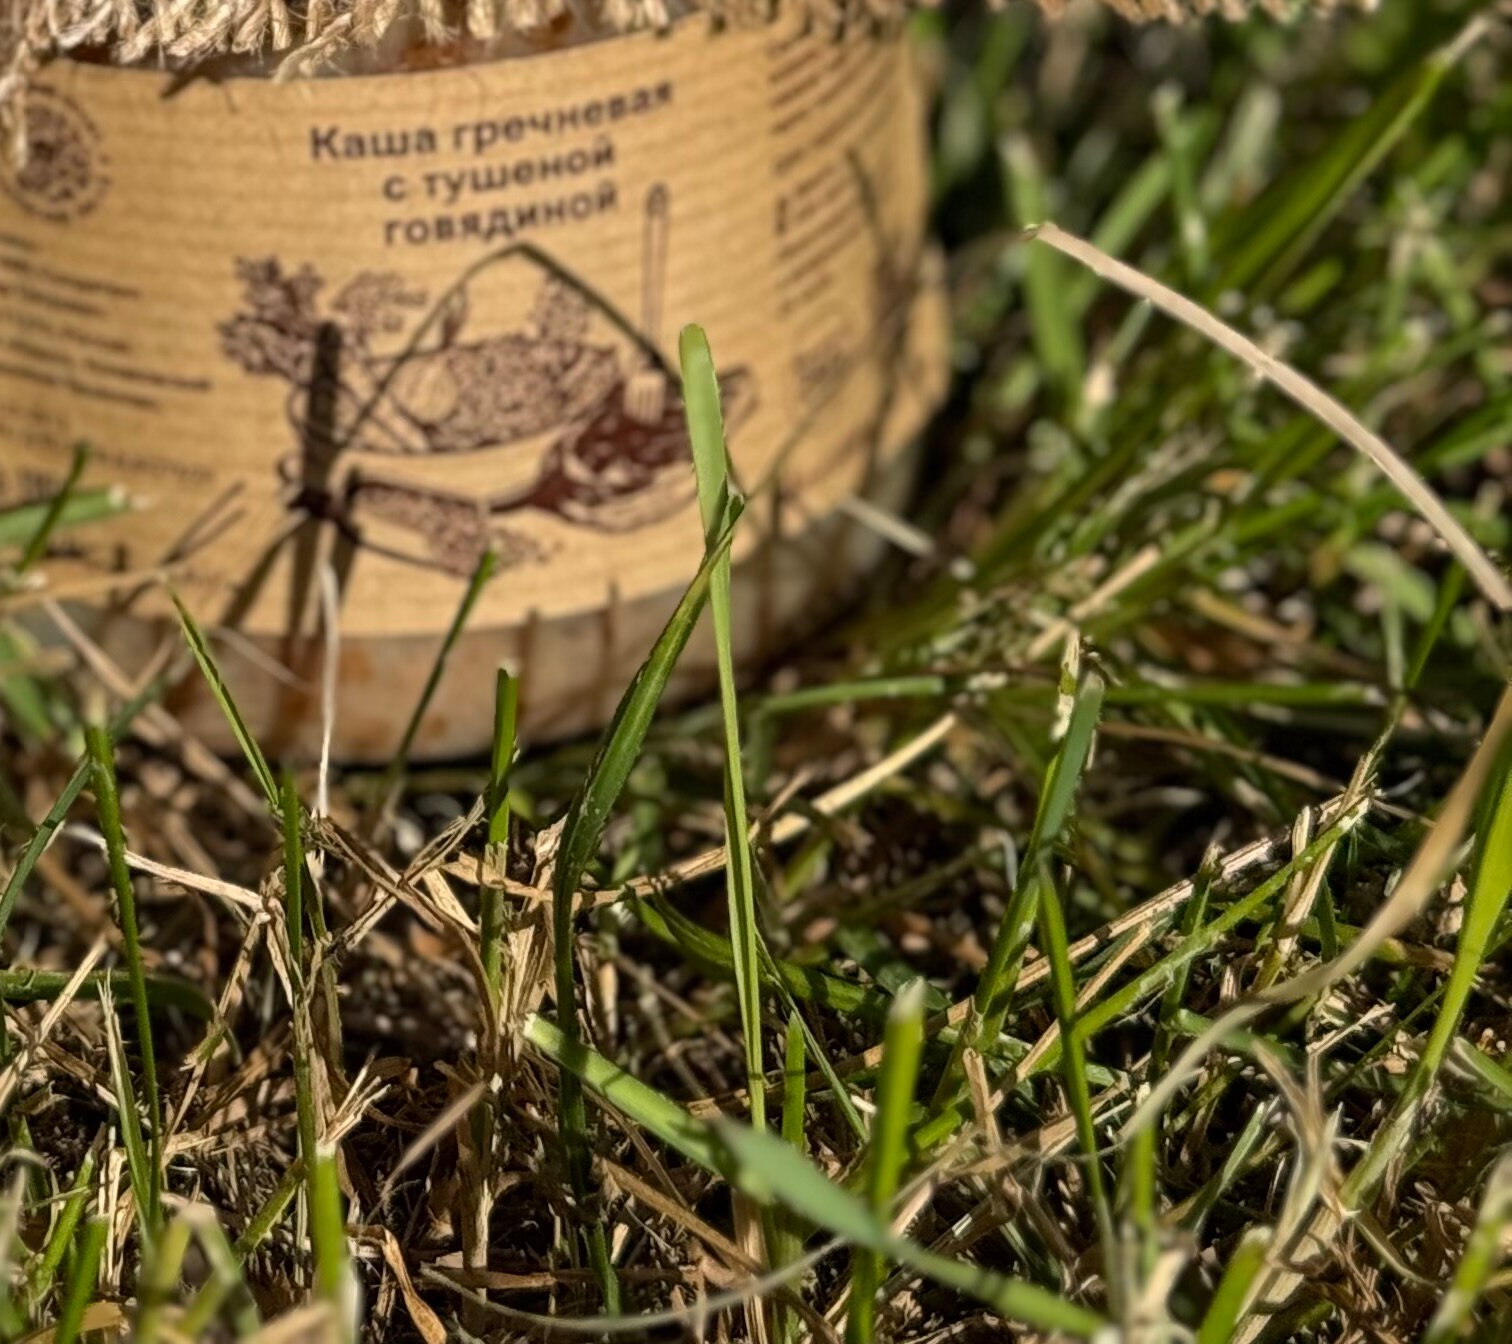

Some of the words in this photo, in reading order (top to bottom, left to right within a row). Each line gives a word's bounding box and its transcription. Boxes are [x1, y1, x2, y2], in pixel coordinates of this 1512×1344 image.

[310, 125, 438, 161] Каша
[451, 79, 675, 155] гречневая
[381, 175, 407, 202] с
[422, 132, 618, 206] тушеной
[383, 177, 619, 248] говядиной
